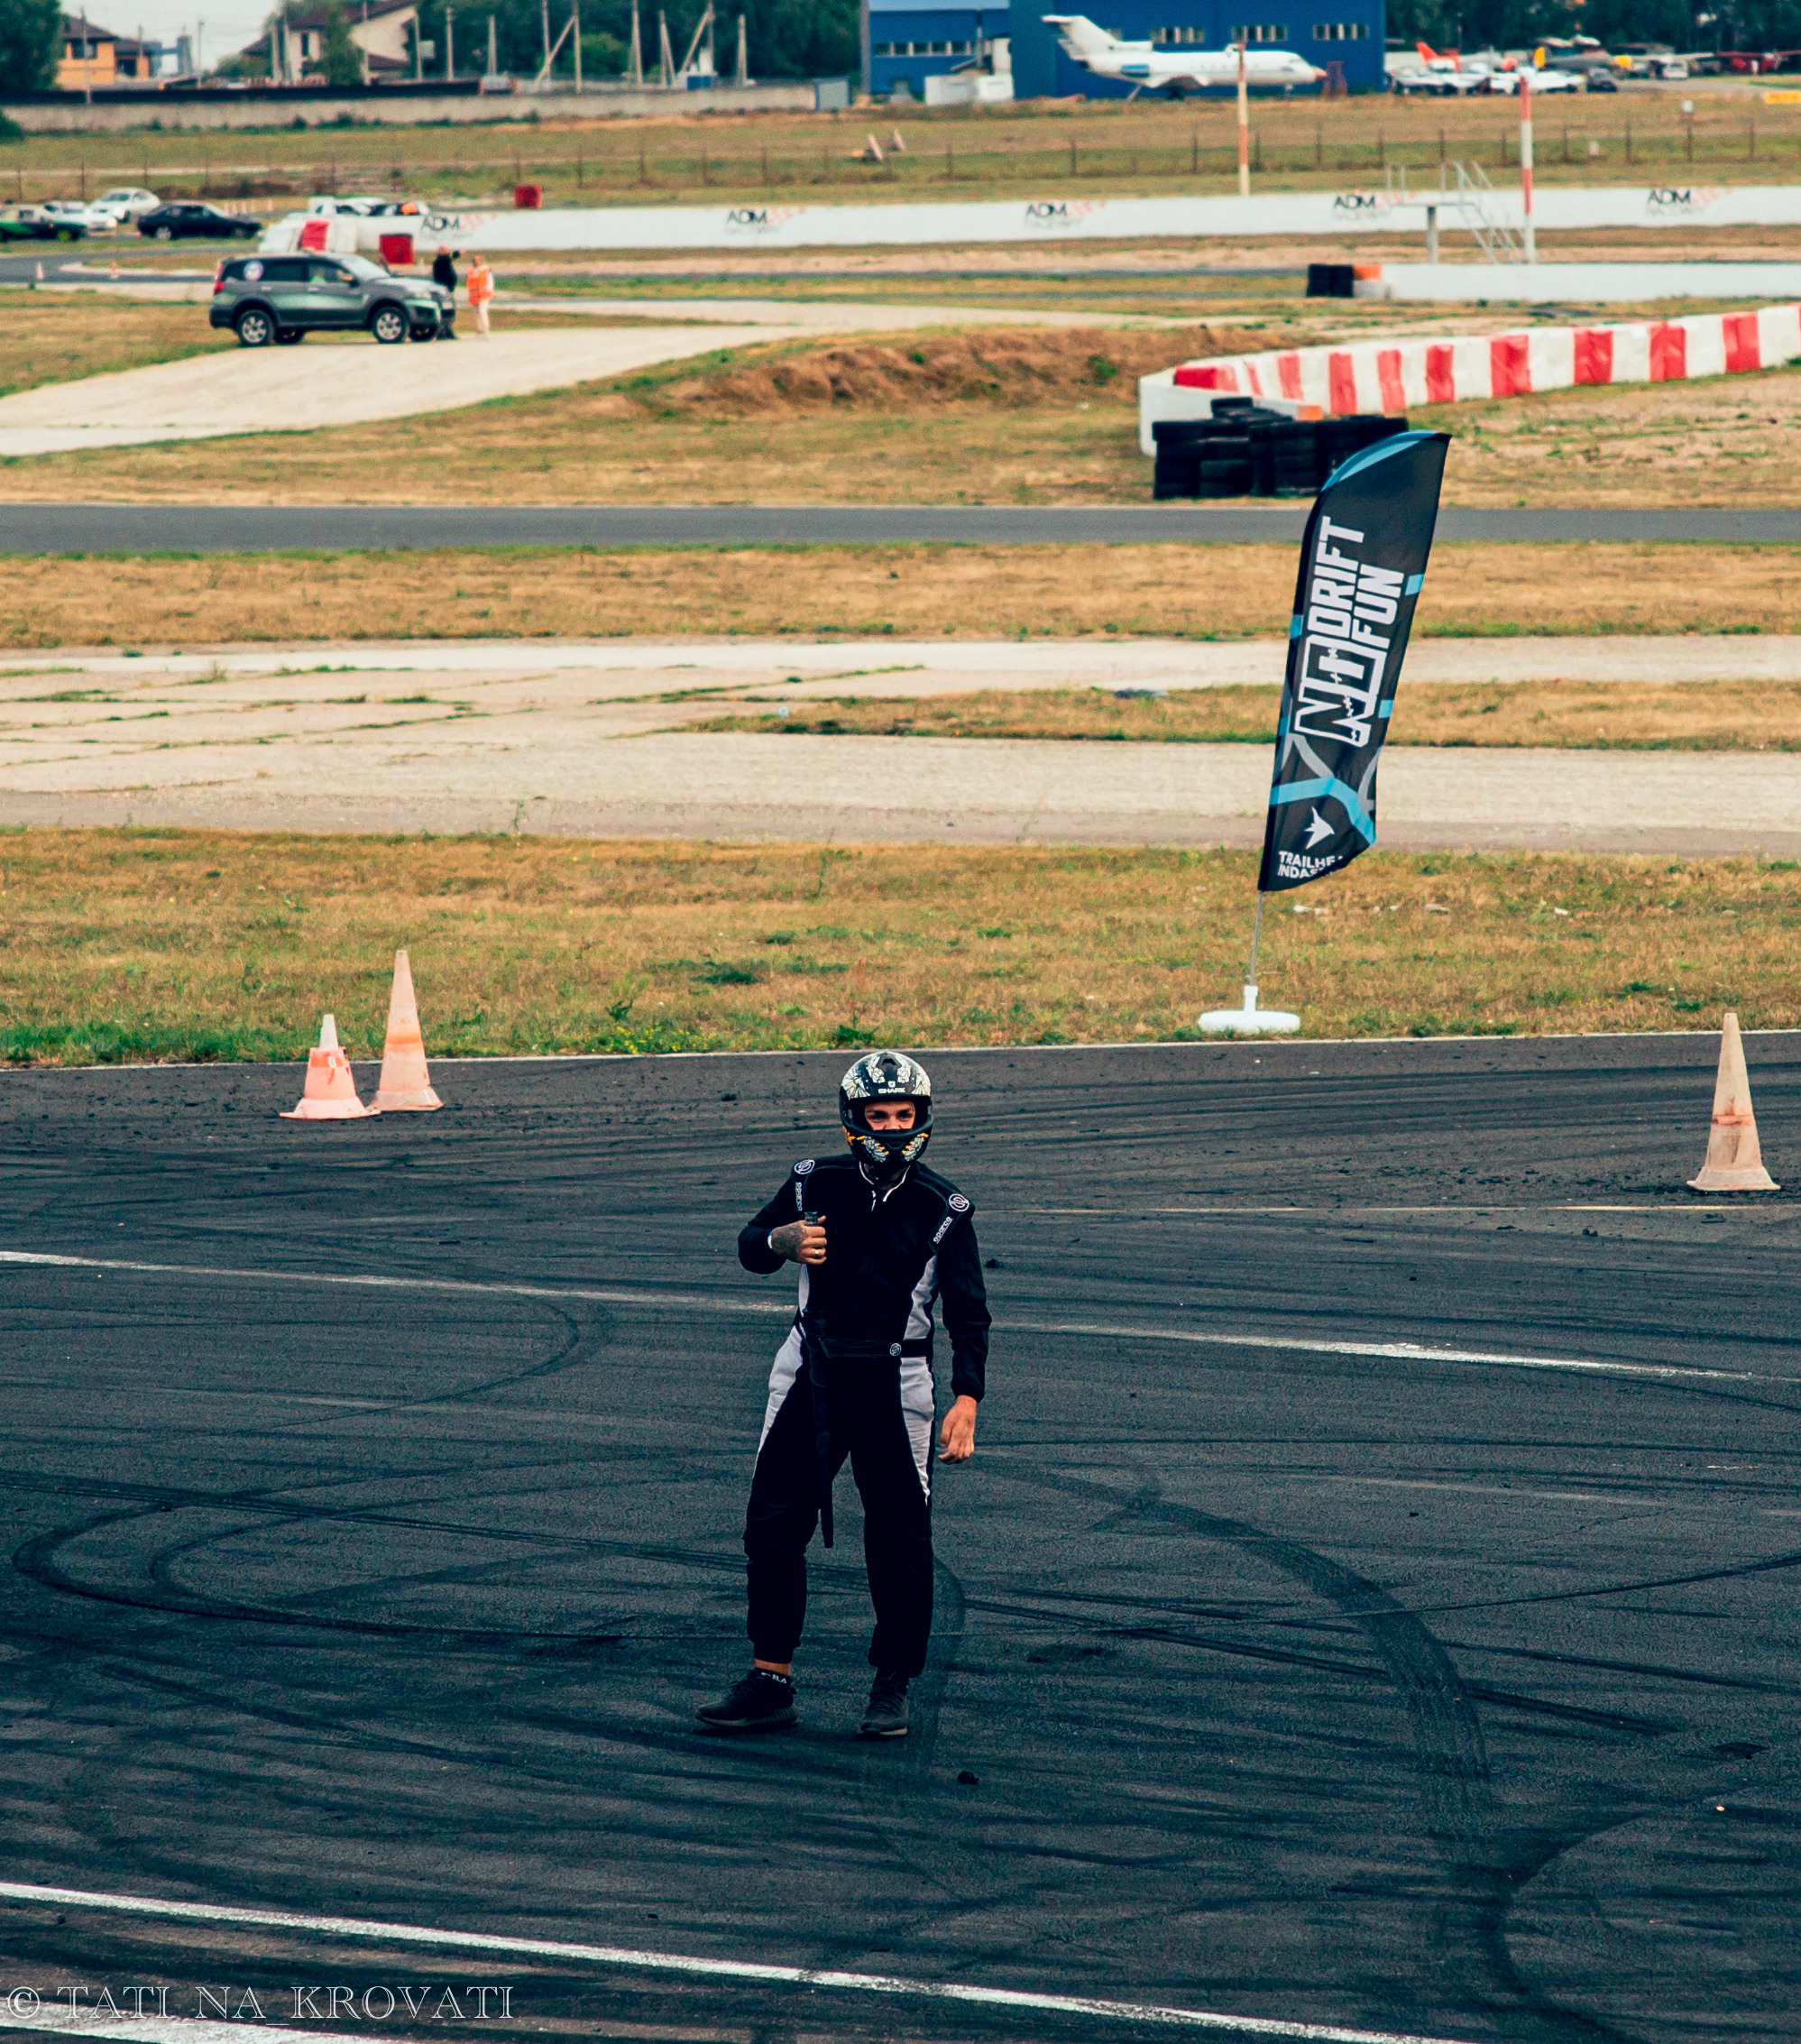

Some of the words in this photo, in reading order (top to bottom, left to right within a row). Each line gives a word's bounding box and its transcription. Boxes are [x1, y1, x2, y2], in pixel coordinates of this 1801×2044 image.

[1333, 195, 1375, 209] ADM
[1648, 189, 1691, 206] ADM
[726, 208, 767, 225] ADM
[1025, 202, 1067, 218] ADM
[419, 216, 460, 232] ADM
[1307, 515, 1365, 639] DRIFT
[1351, 564, 1405, 649] FUN
[1278, 851, 1343, 869] TRAILHE
[933, 1216, 953, 1244] sparco
